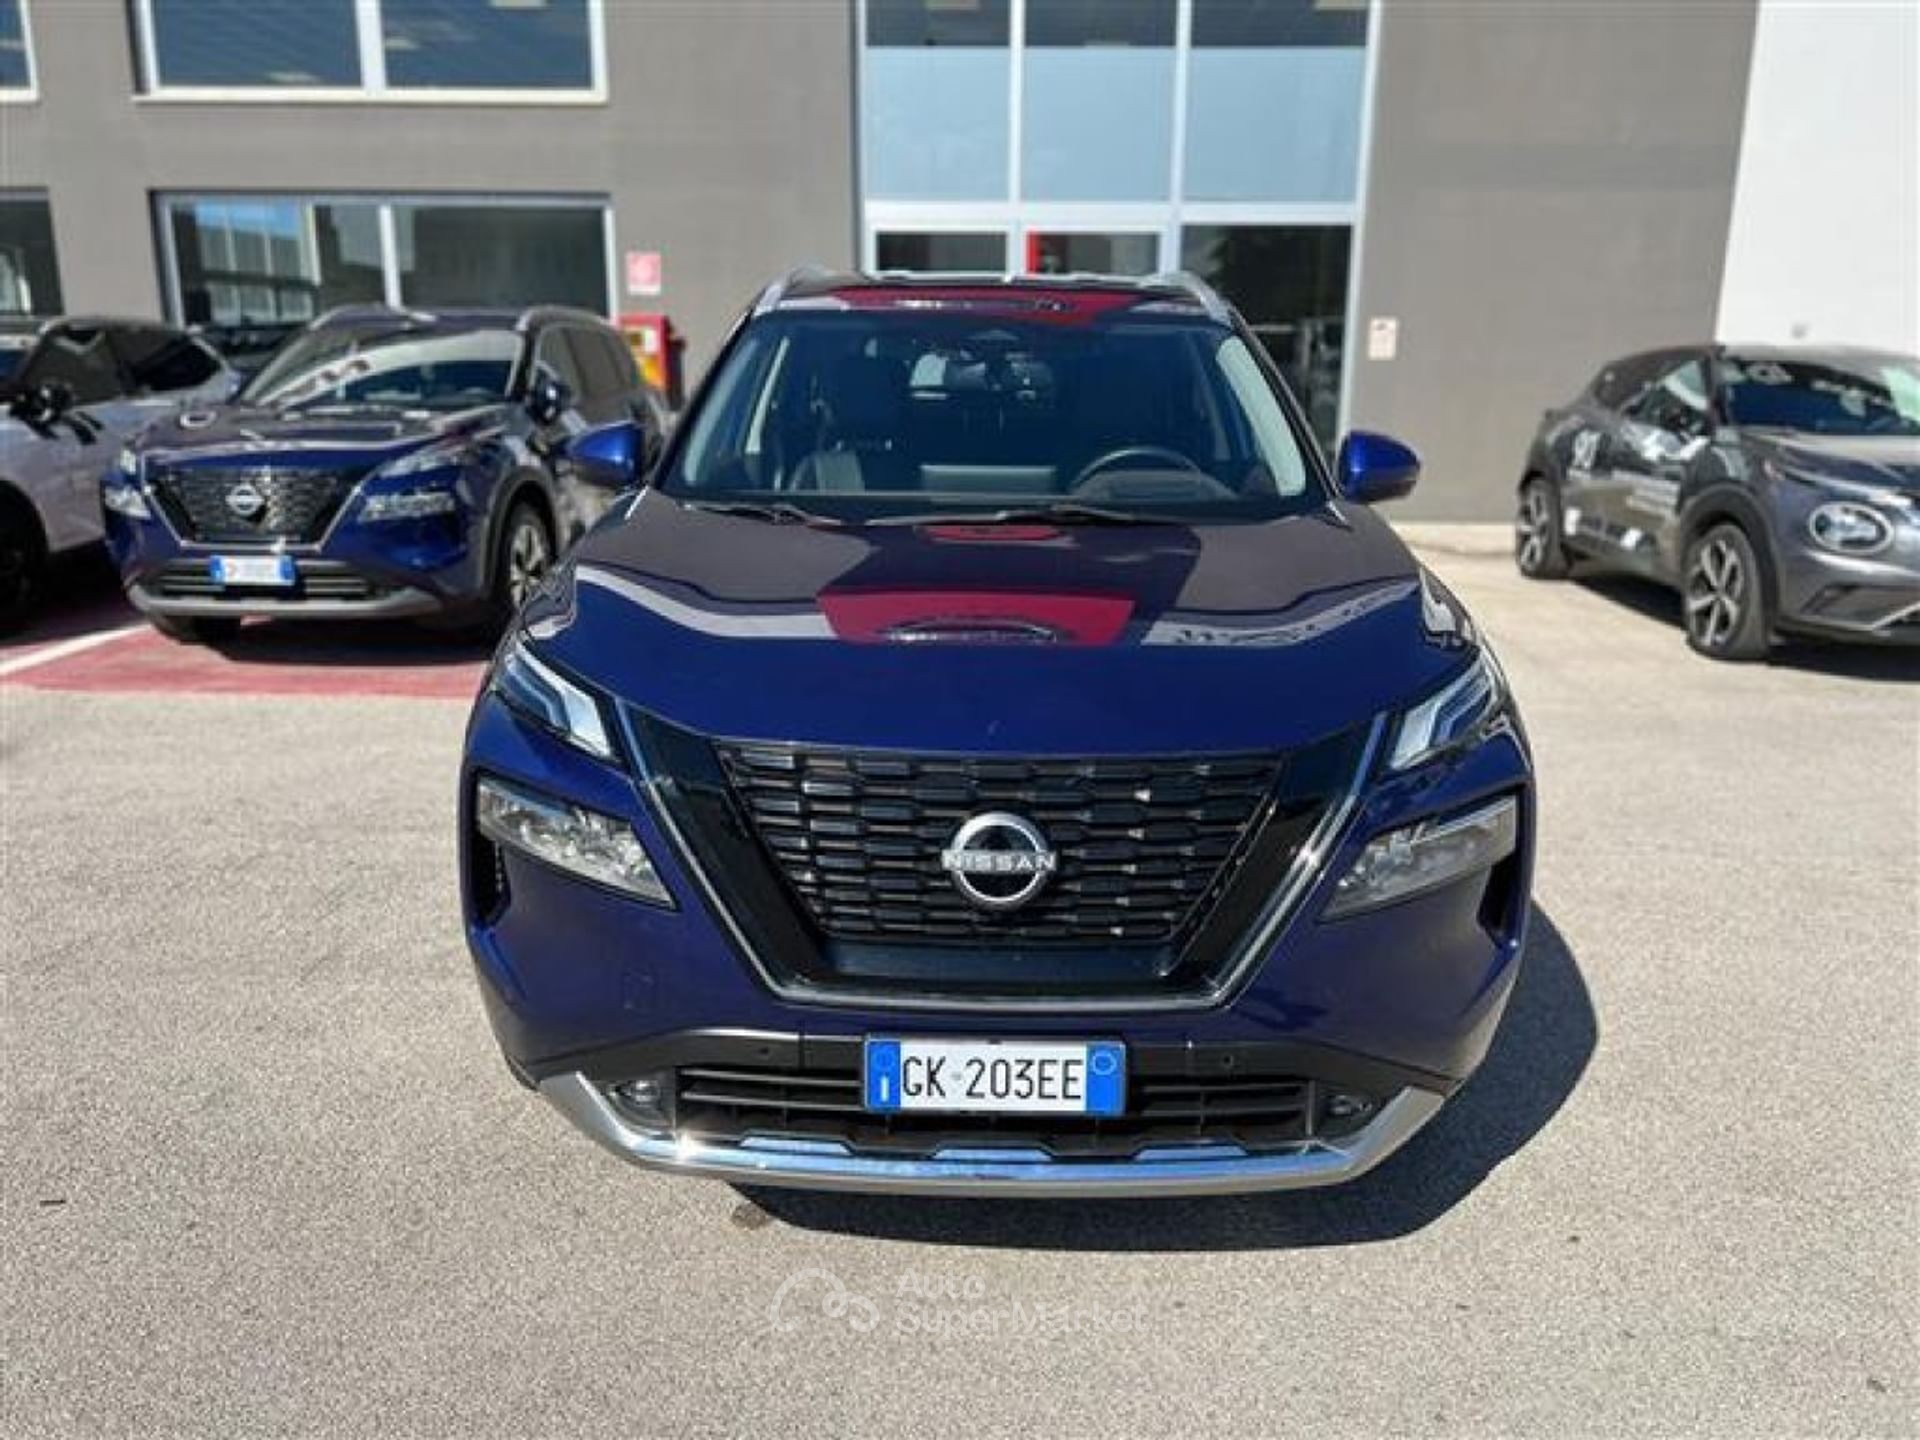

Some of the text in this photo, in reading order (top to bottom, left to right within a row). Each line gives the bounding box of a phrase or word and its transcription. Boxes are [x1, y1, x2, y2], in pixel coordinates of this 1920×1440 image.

[942, 849, 1057, 871] NISSAN
[902, 1056, 1084, 1100] GK 203EE
